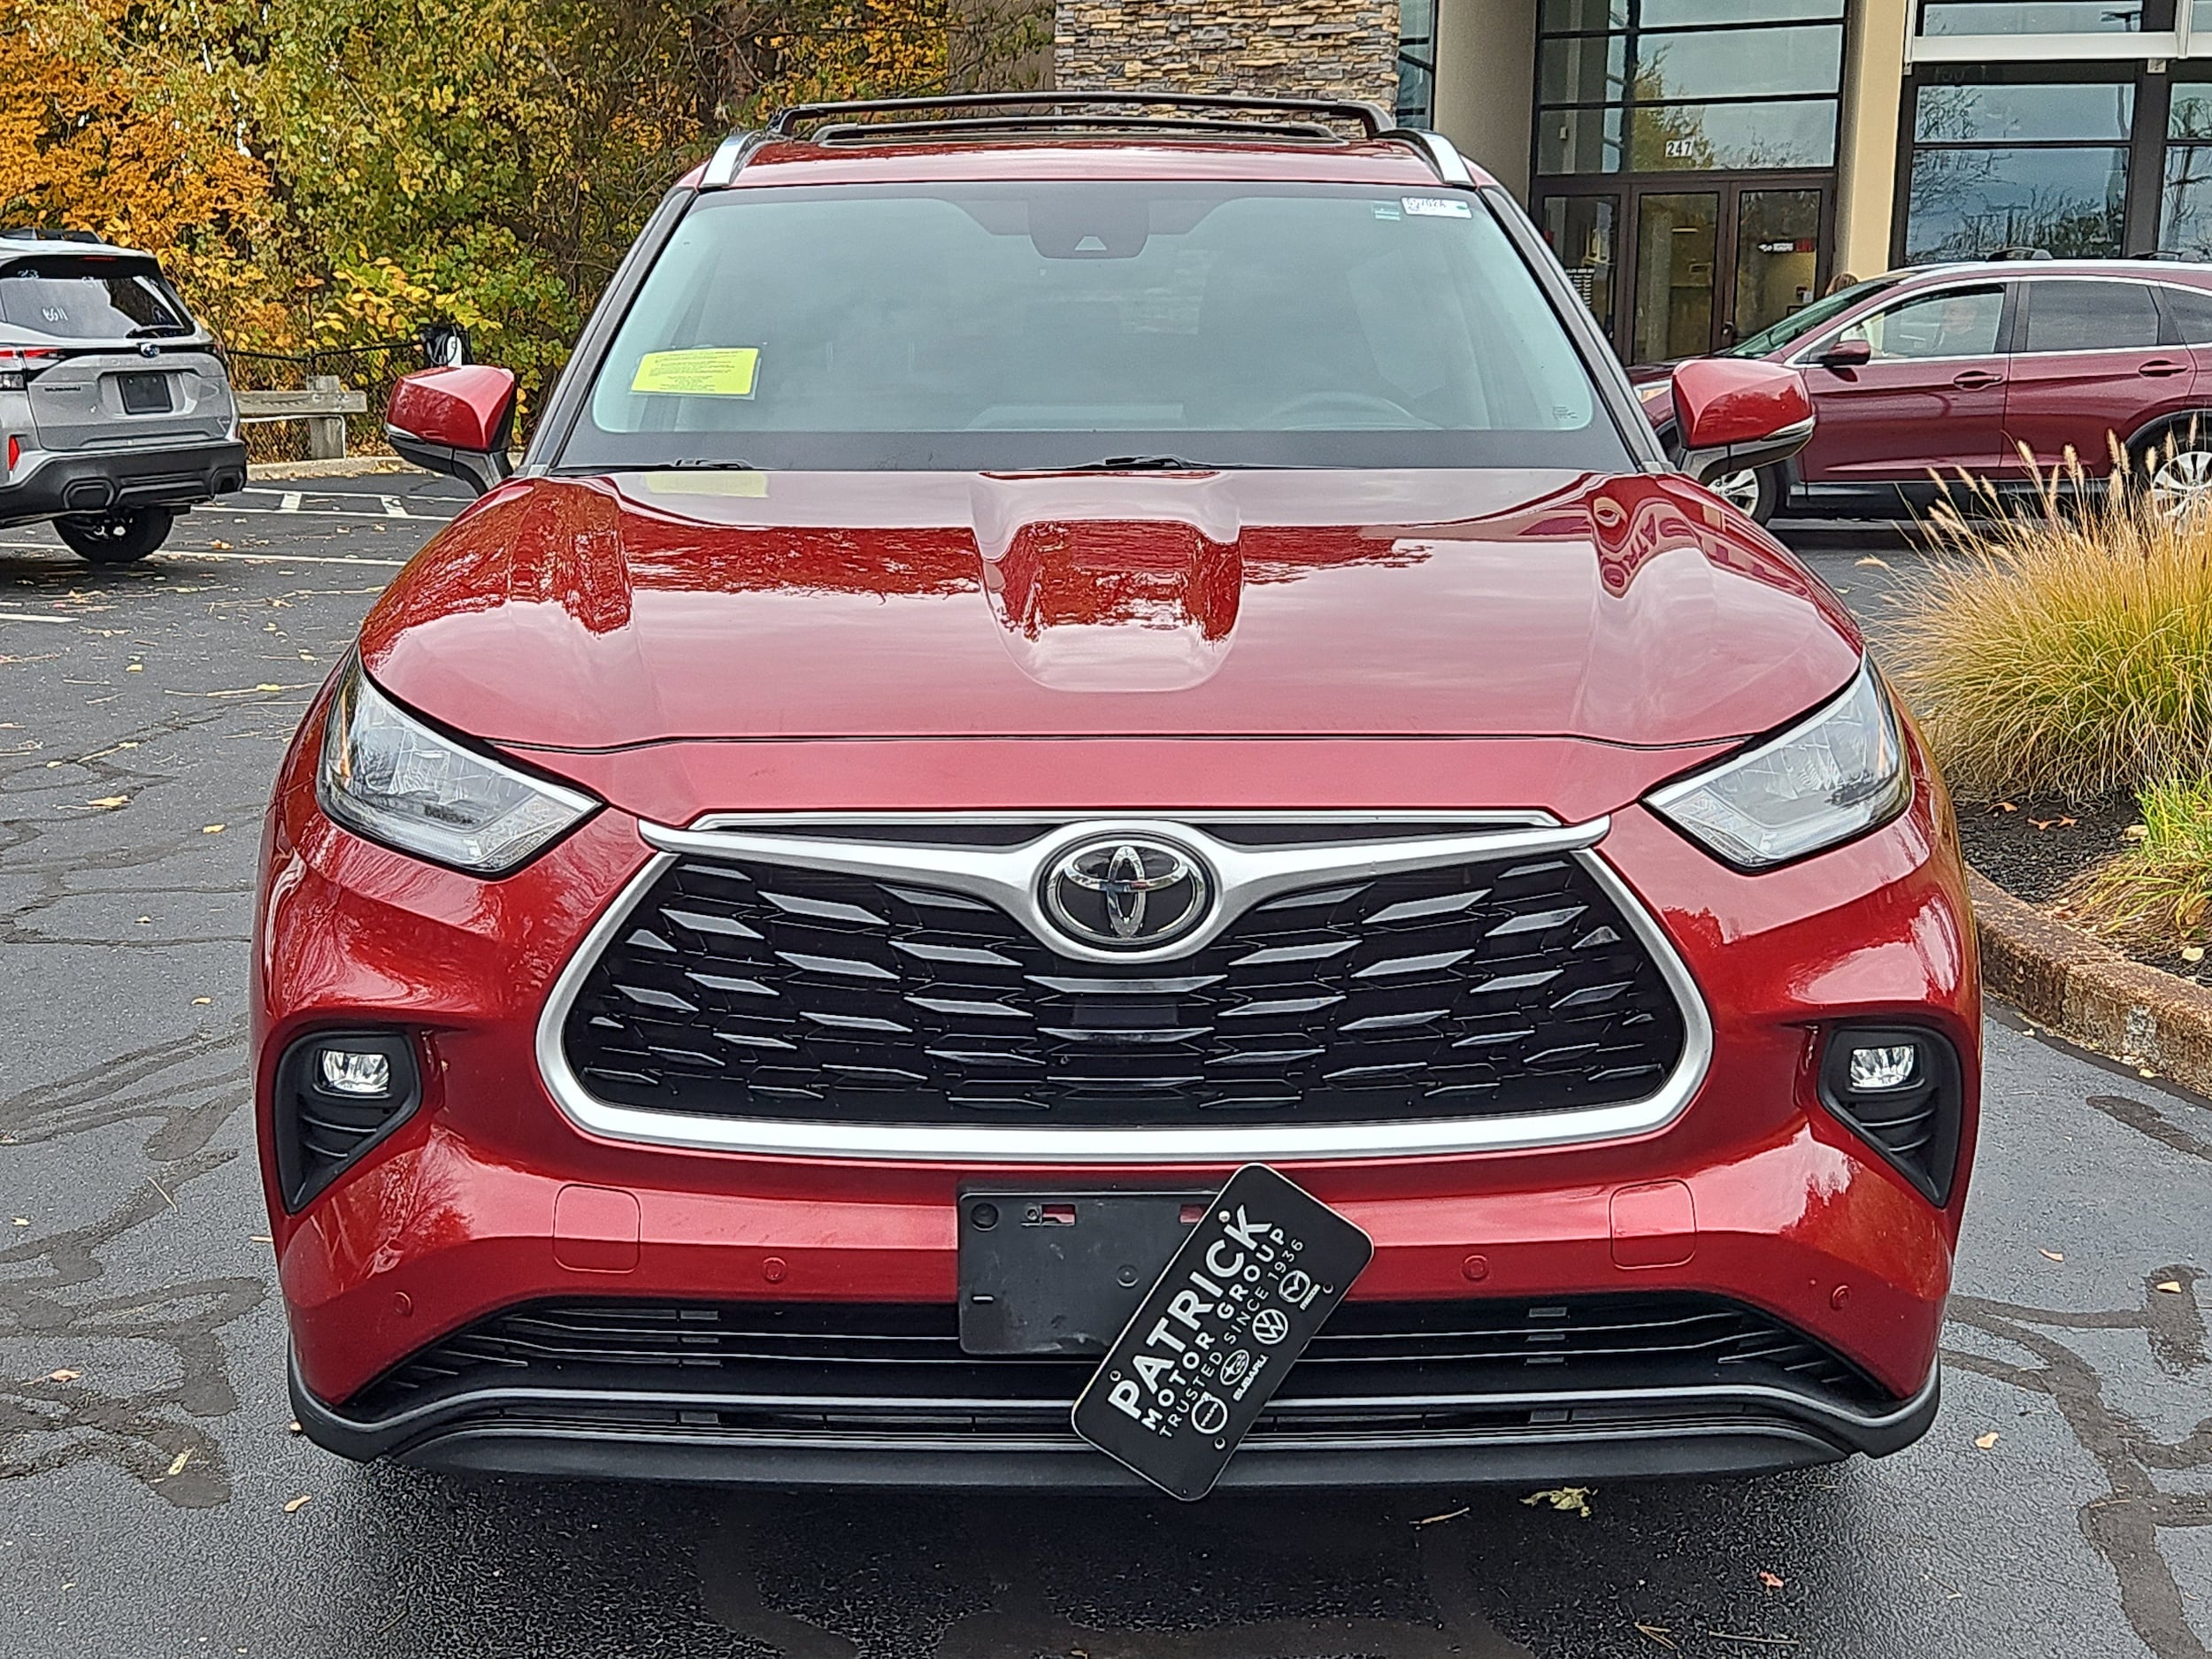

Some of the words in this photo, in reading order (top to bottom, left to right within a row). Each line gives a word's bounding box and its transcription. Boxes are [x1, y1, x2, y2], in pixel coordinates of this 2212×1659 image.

[1667, 142, 1691, 156] 247
[1107, 1204, 1272, 1420] PATRICK
[1141, 1331, 1216, 1432] MOTOR
[1216, 1227, 1286, 1320] GROUP
[1159, 1351, 1224, 1439] TRUSTED
[1224, 1287, 1270, 1346] SINCE
[1267, 1238, 1304, 1282] 1936
